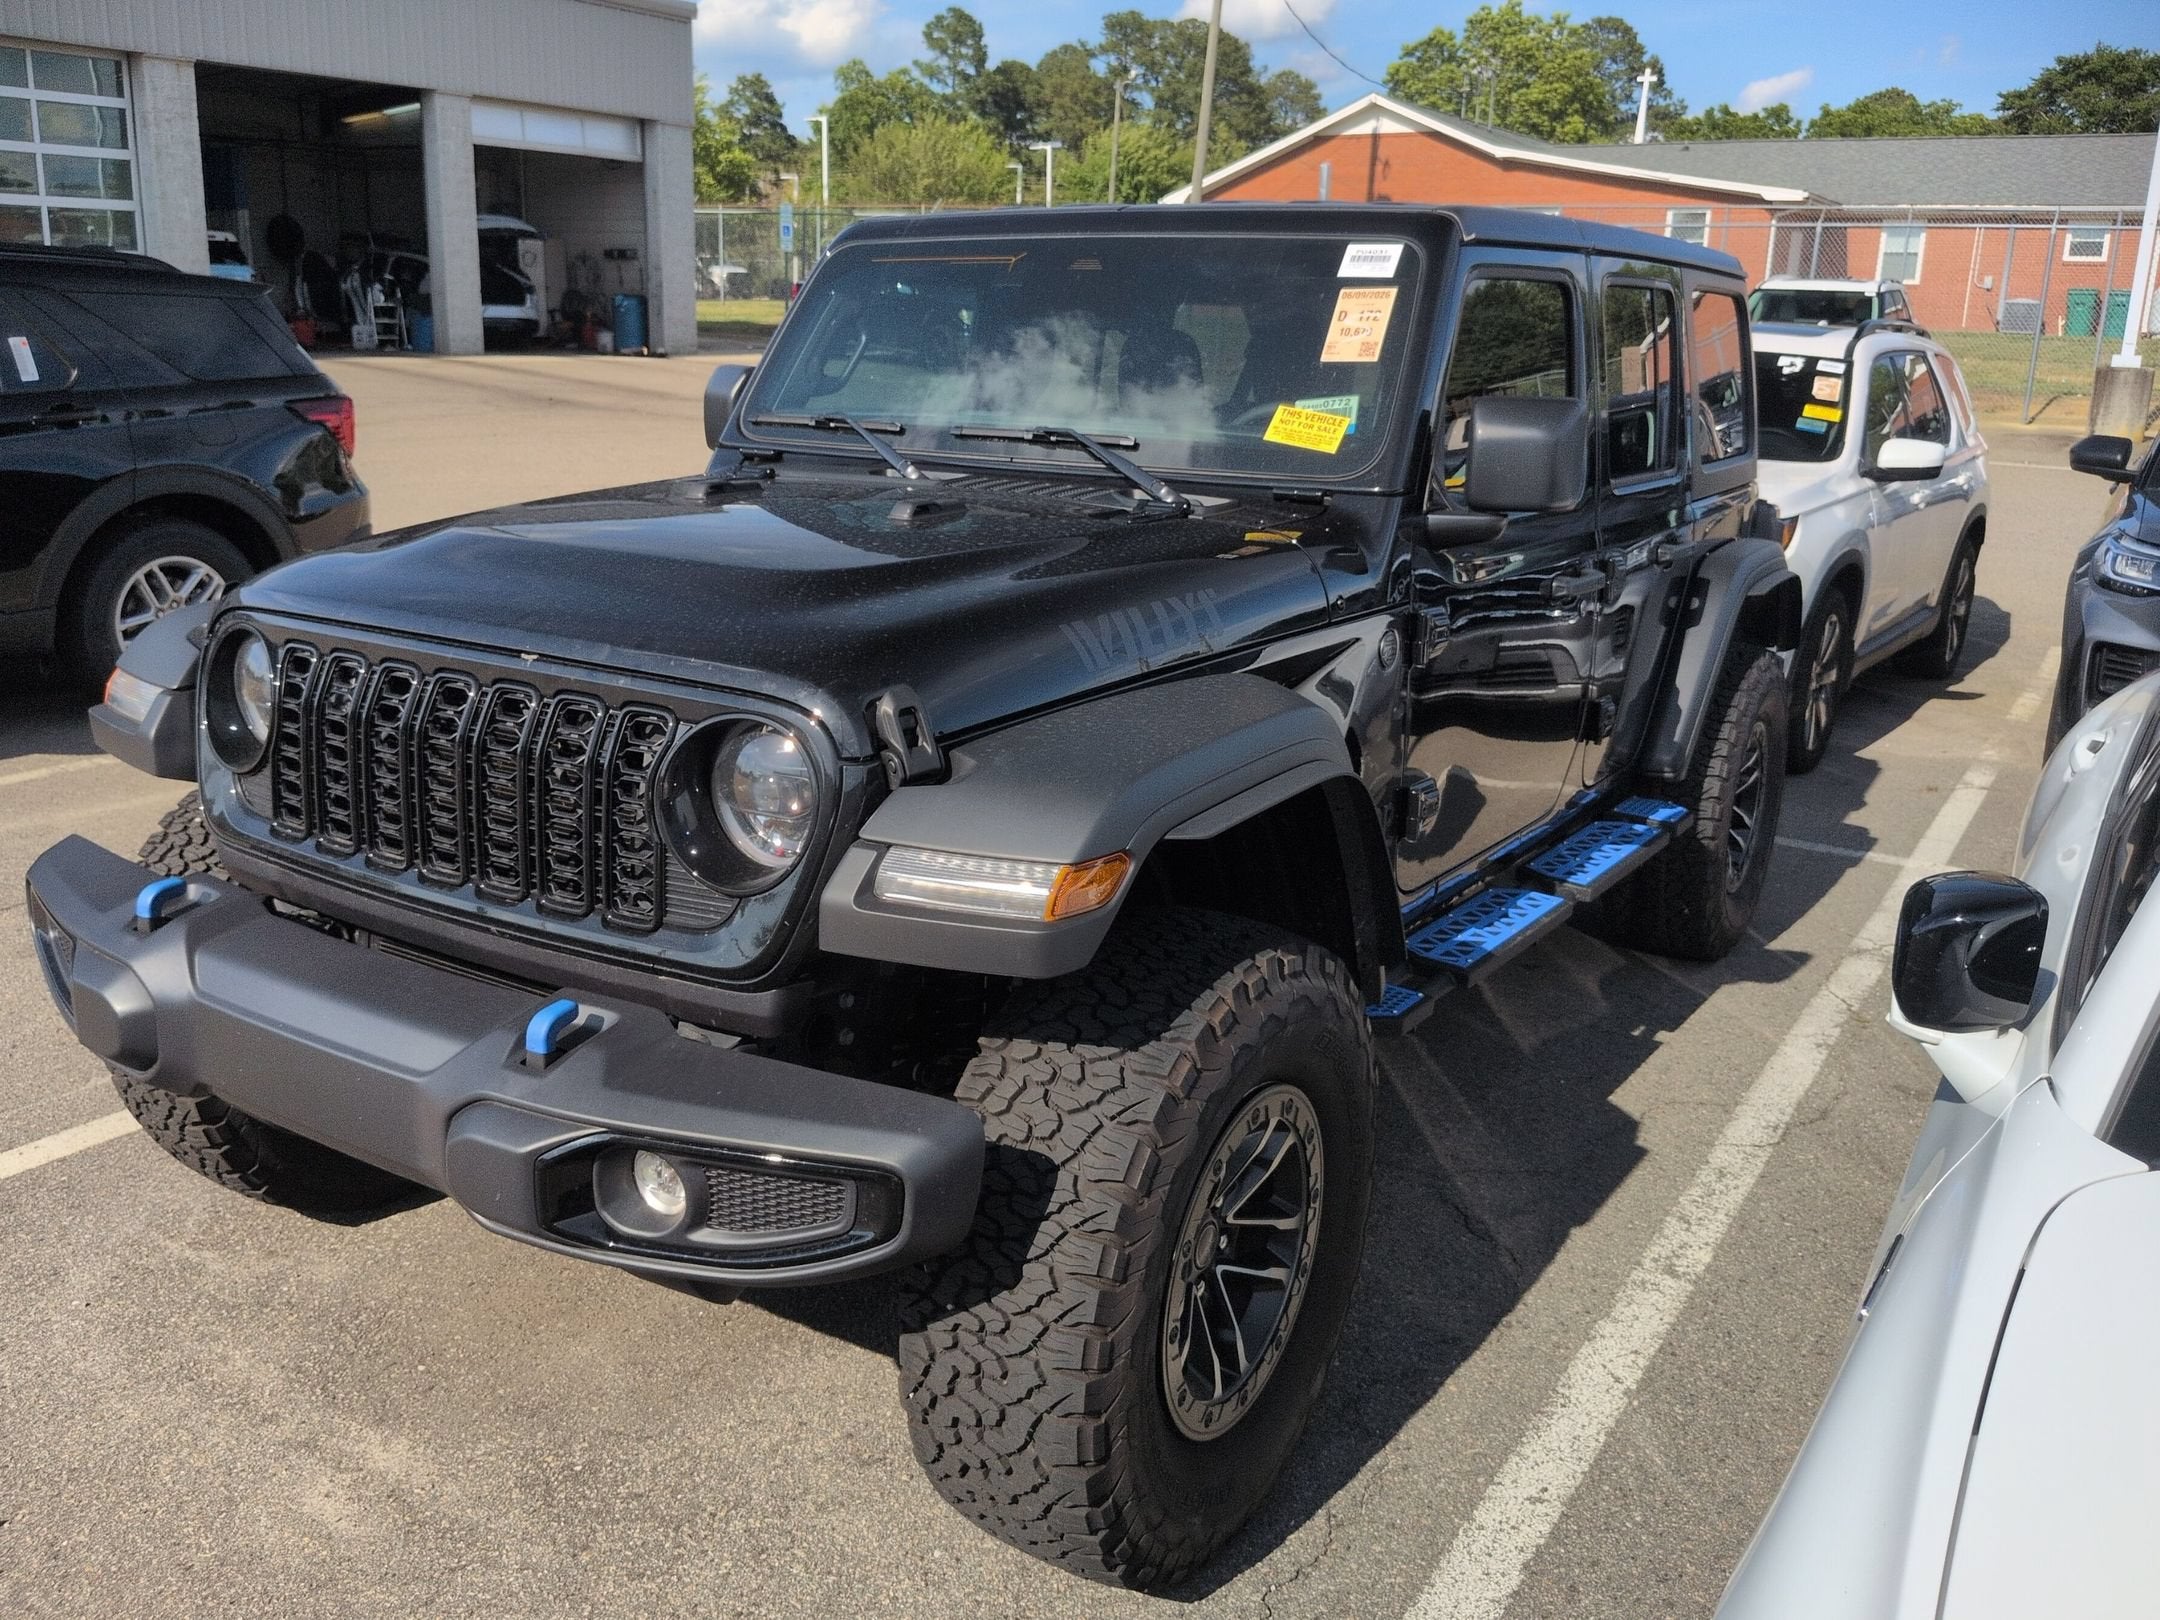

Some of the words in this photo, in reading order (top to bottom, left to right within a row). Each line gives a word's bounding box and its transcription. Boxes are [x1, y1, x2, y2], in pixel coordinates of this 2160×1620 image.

[1338, 310, 1348, 321] D
[1281, 408, 1302, 419] THIS
[1304, 413, 1345, 427] VEHICLE
[1279, 418, 1295, 427] NOT
[1297, 421, 1315, 430] FOR
[1317, 425, 1338, 434] SALE
